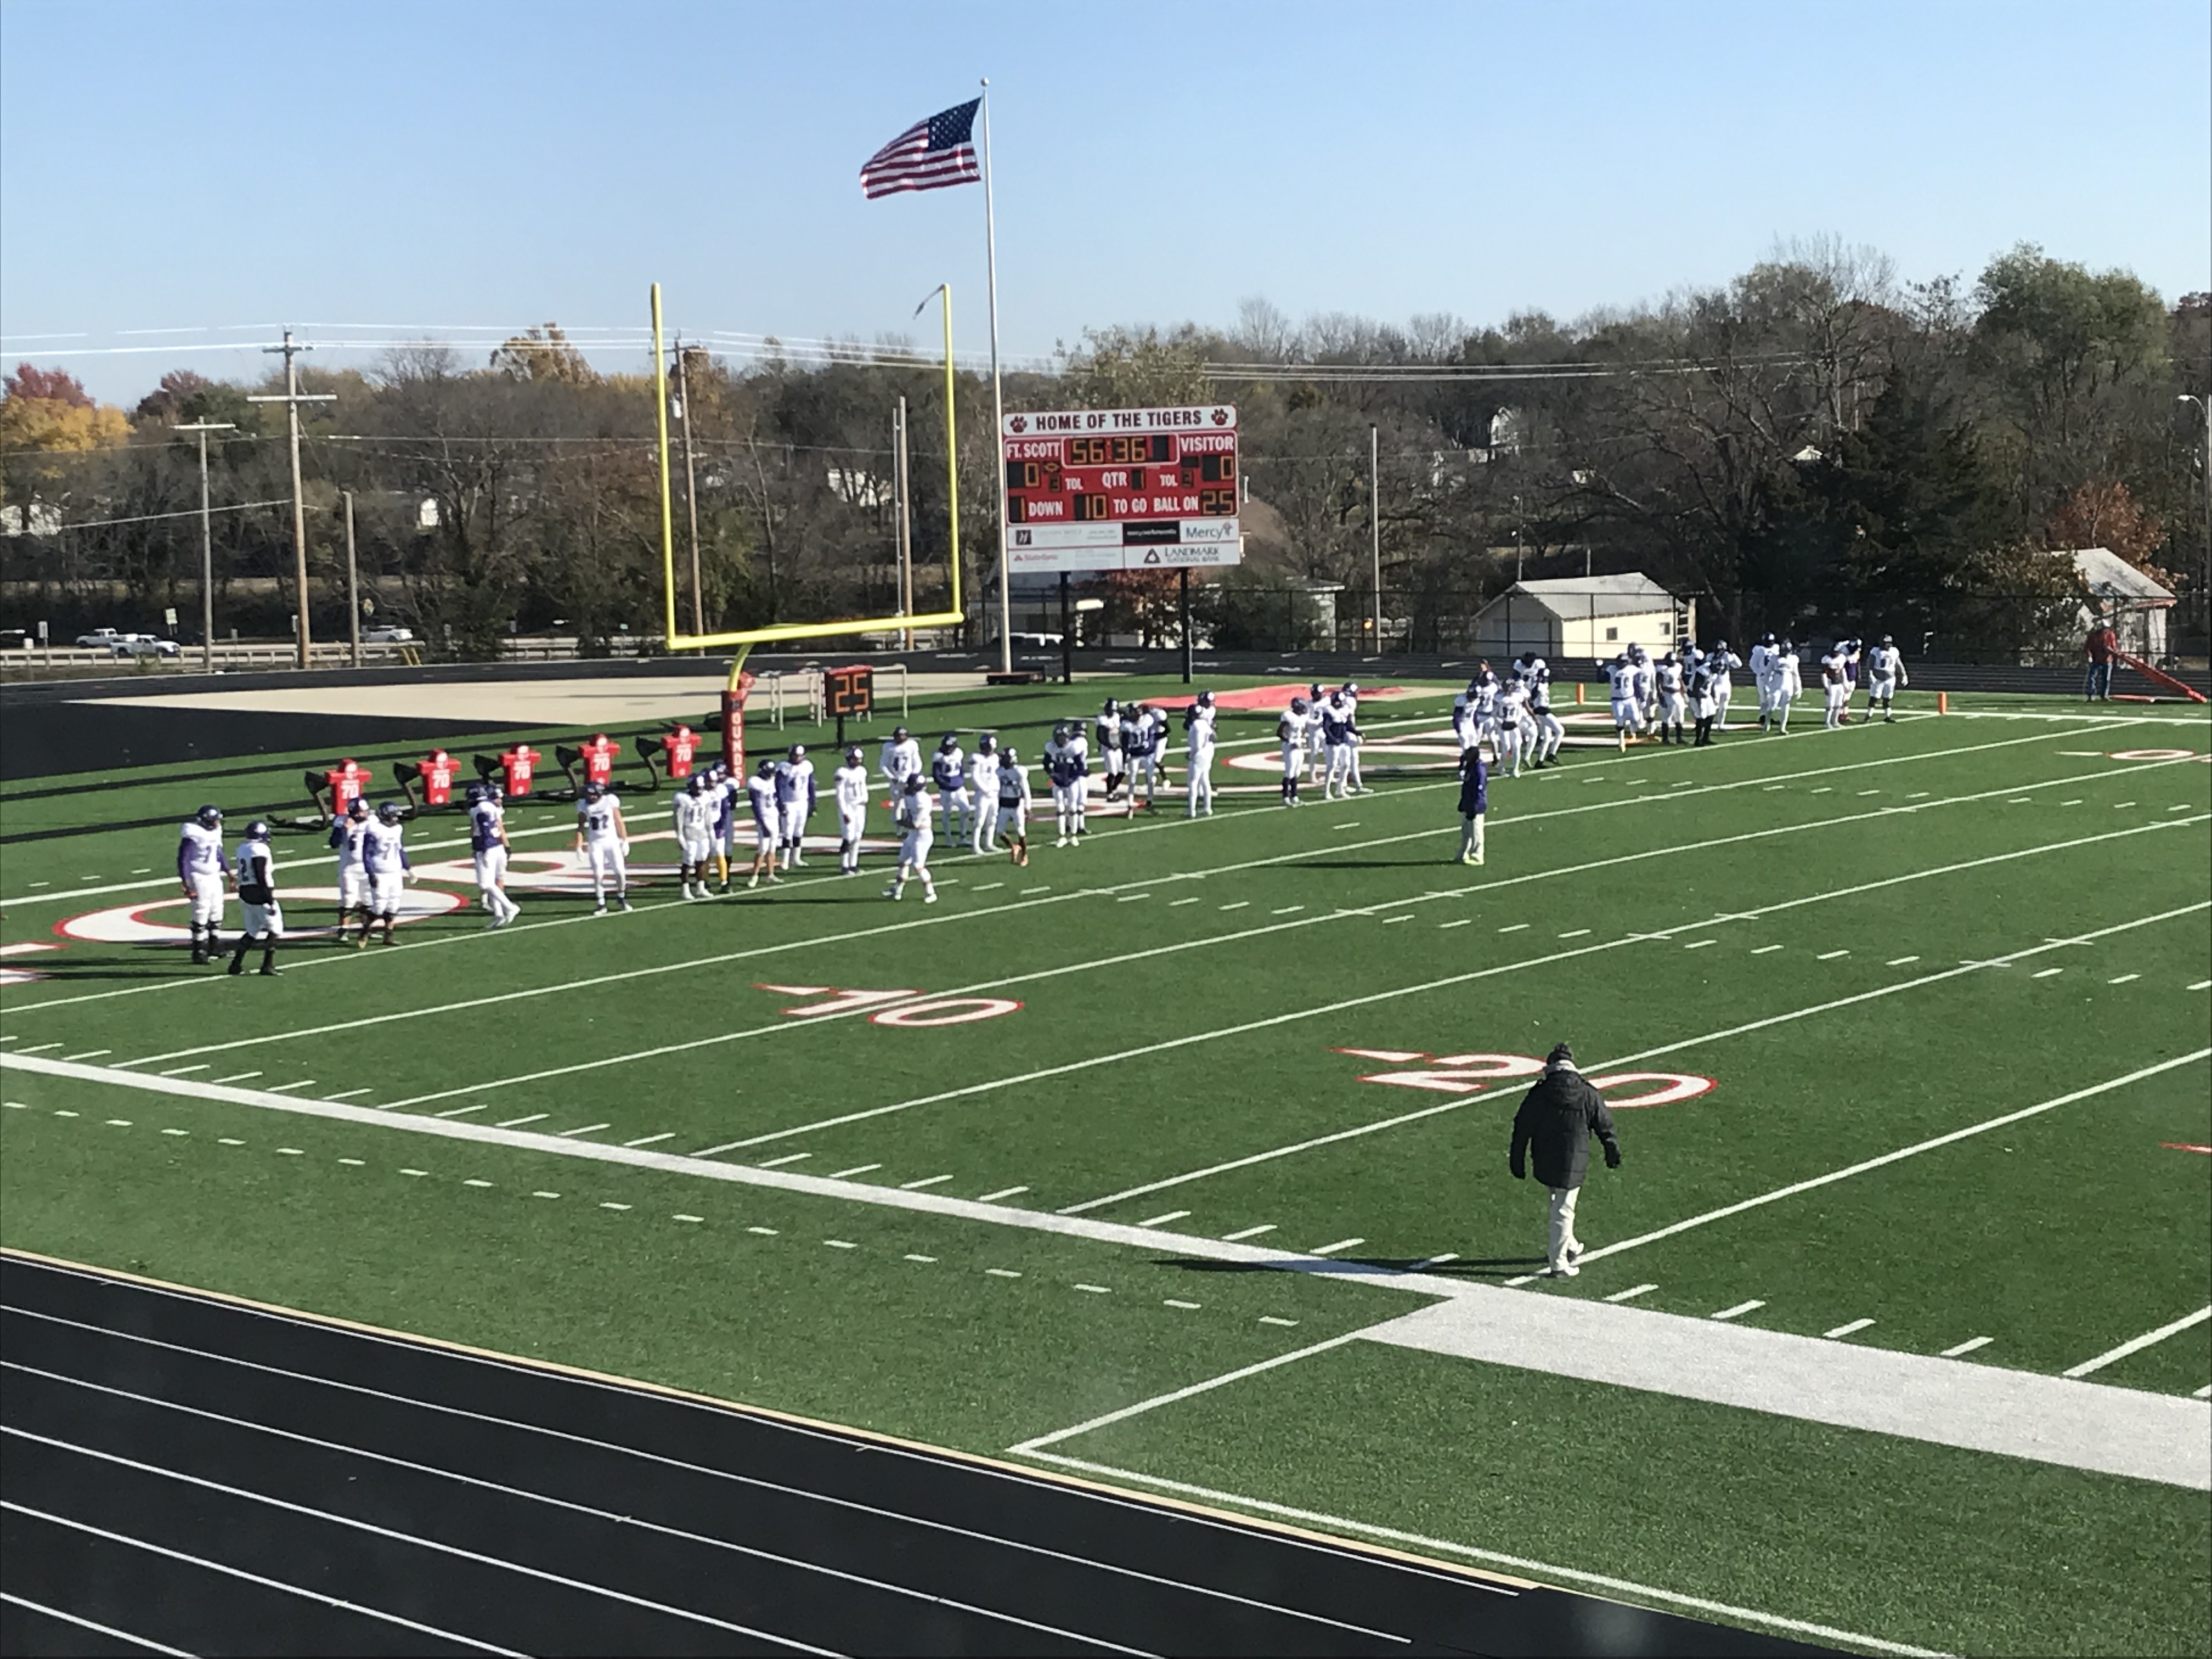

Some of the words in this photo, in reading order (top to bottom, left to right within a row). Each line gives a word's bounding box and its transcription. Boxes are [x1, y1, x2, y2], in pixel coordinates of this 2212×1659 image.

[1036, 415, 1081, 430] HOME
[1087, 414, 1106, 428] OF
[1113, 413, 1142, 427] THE
[1148, 410, 1201, 426] TIGERS
[1006, 443, 1022, 458] FT.
[1023, 442, 1060, 458] SCOTT
[1180, 436, 1234, 452] VISITOR
[1025, 462, 1040, 487] 0
[1220, 455, 1234, 479] 0
[1065, 477, 1084, 489] TOL
[1102, 471, 1127, 488] QTR
[1159, 474, 1178, 487] TOL
[1028, 501, 1063, 517] DOWN
[1113, 499, 1128, 514] TO
[1131, 498, 1147, 513] GO
[1153, 496, 1181, 512] BALL
[1183, 495, 1199, 511] ON
[1202, 490, 1234, 515] 25
[1186, 526, 1222, 539] Mercy
[834, 673, 870, 713] 25
[676, 748, 691, 762] 70
[514, 765, 531, 779] 70
[593, 757, 610, 771] 70
[432, 774, 450, 788] 70
[341, 784, 359, 799] 70
[778, 988, 1025, 1026] 10
[1353, 1052, 1719, 1108] 20
